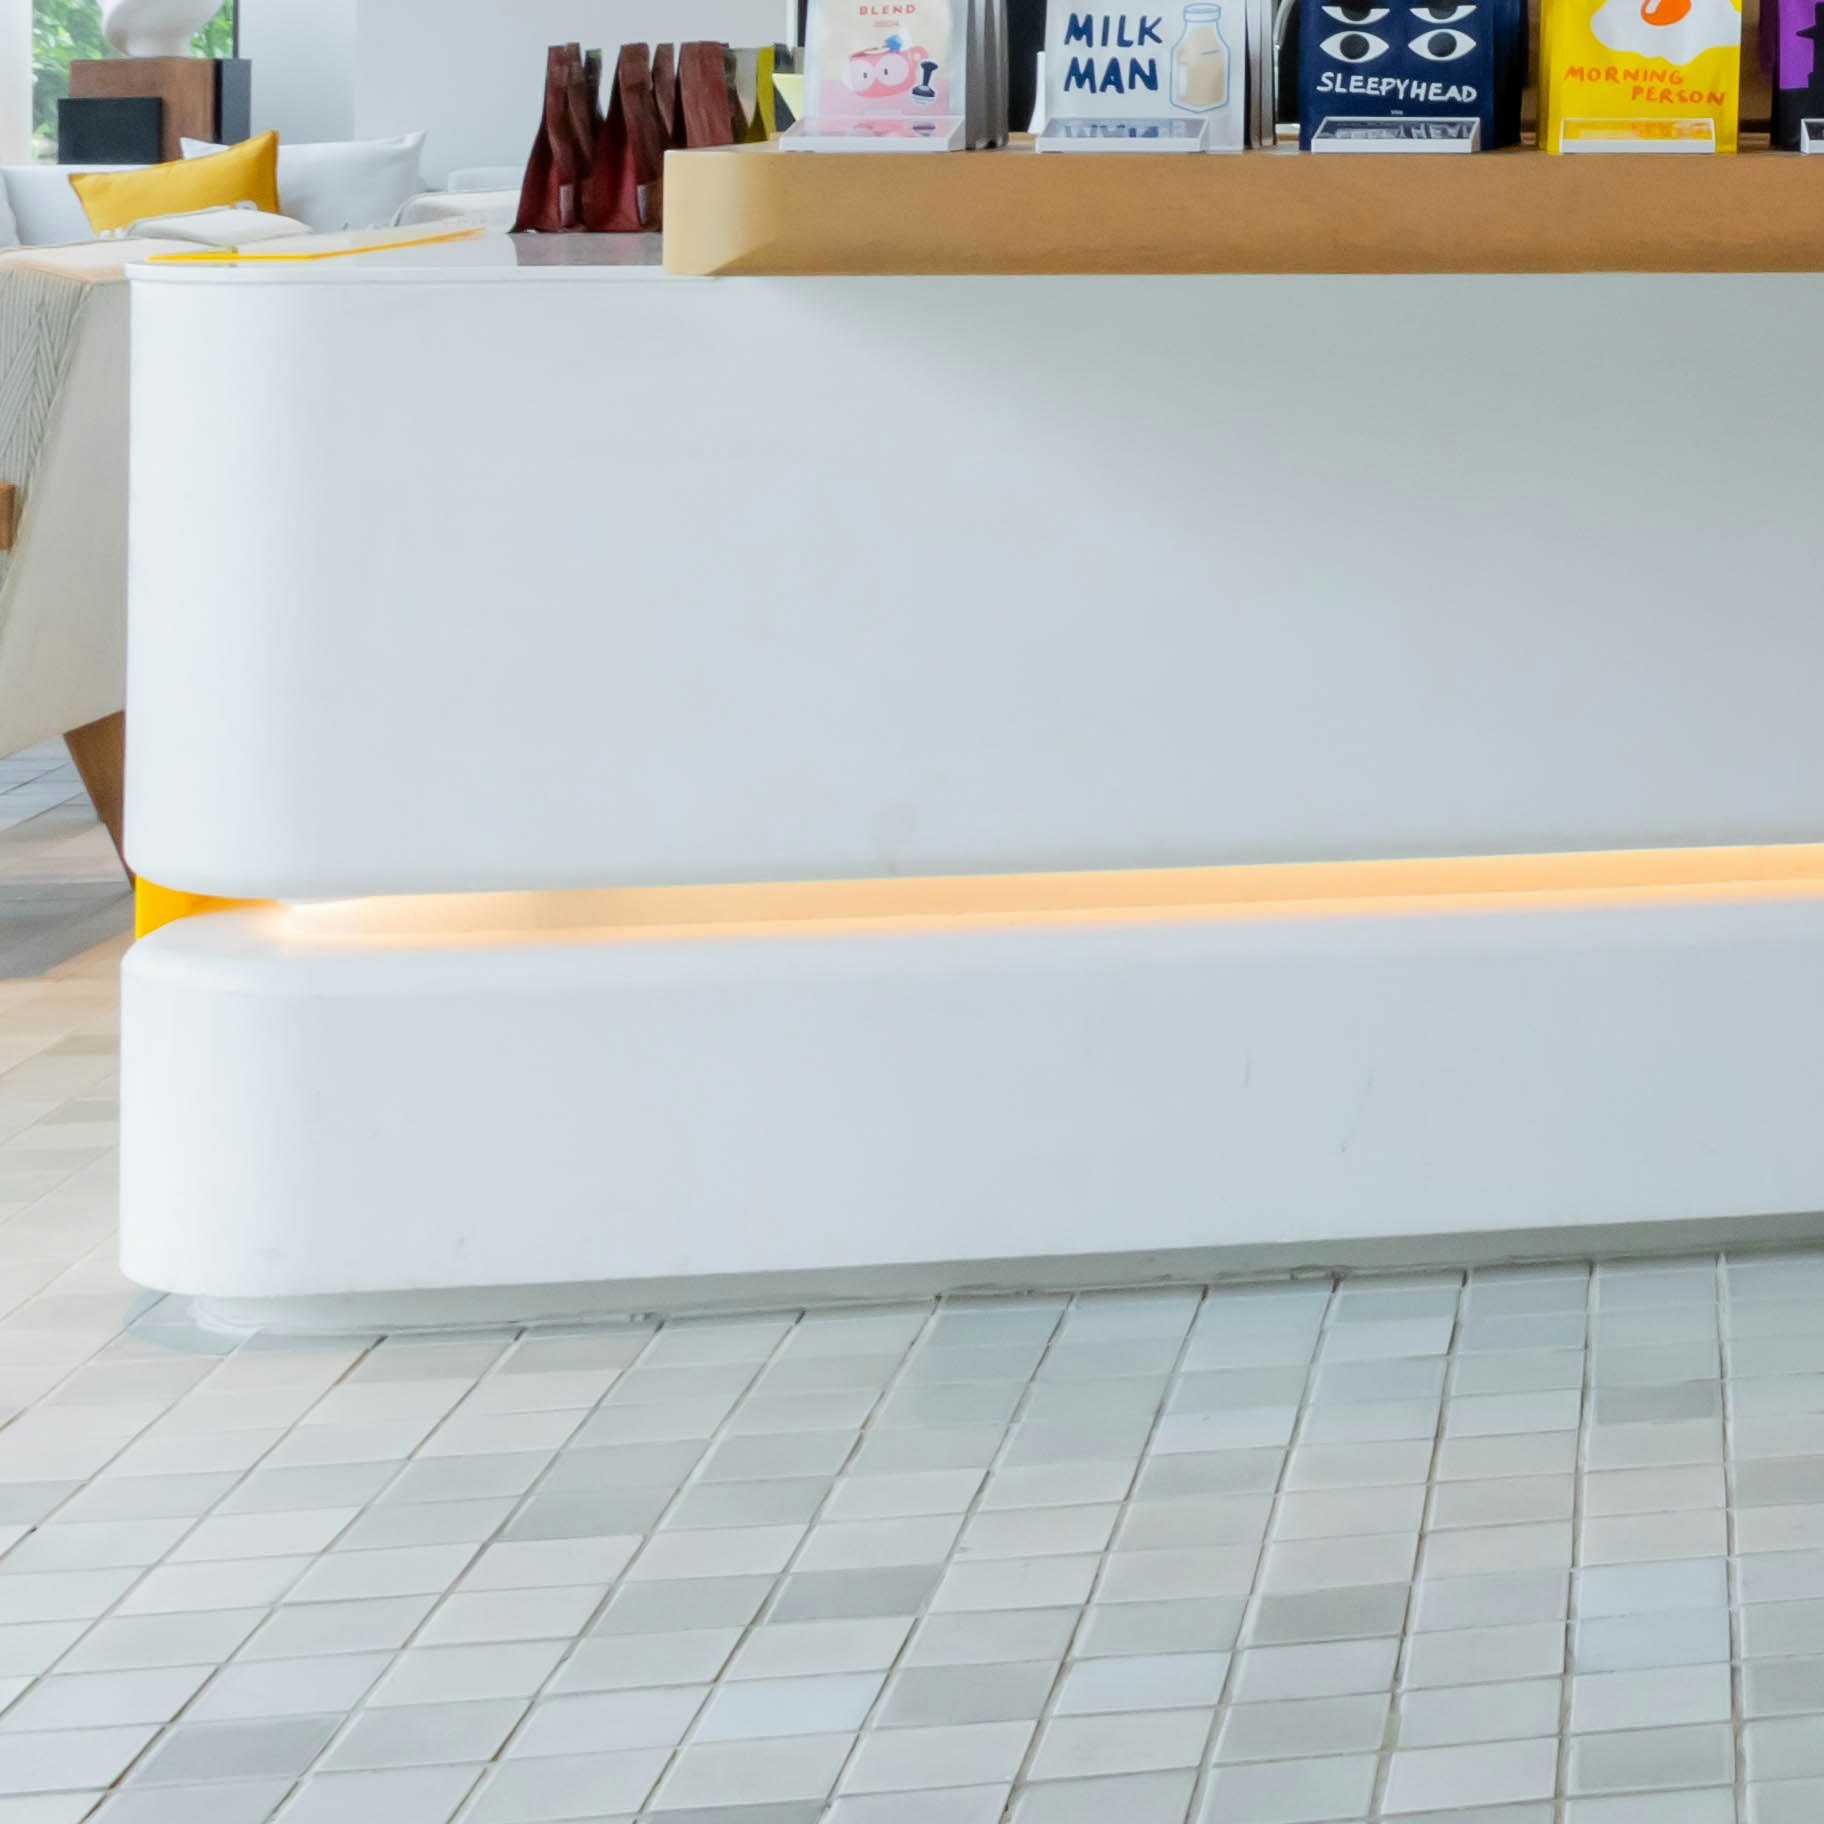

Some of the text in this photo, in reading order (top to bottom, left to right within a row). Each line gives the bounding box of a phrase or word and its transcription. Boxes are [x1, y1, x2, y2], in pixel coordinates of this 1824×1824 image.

[859, 4, 916, 16] BLEND
[1064, 12, 1163, 48] MILK
[1064, 56, 1159, 94] MAN
[1316, 71, 1478, 103] SLEEPYHEAD
[1563, 65, 1684, 85] MORNING
[1631, 85, 1726, 107] PERSON
